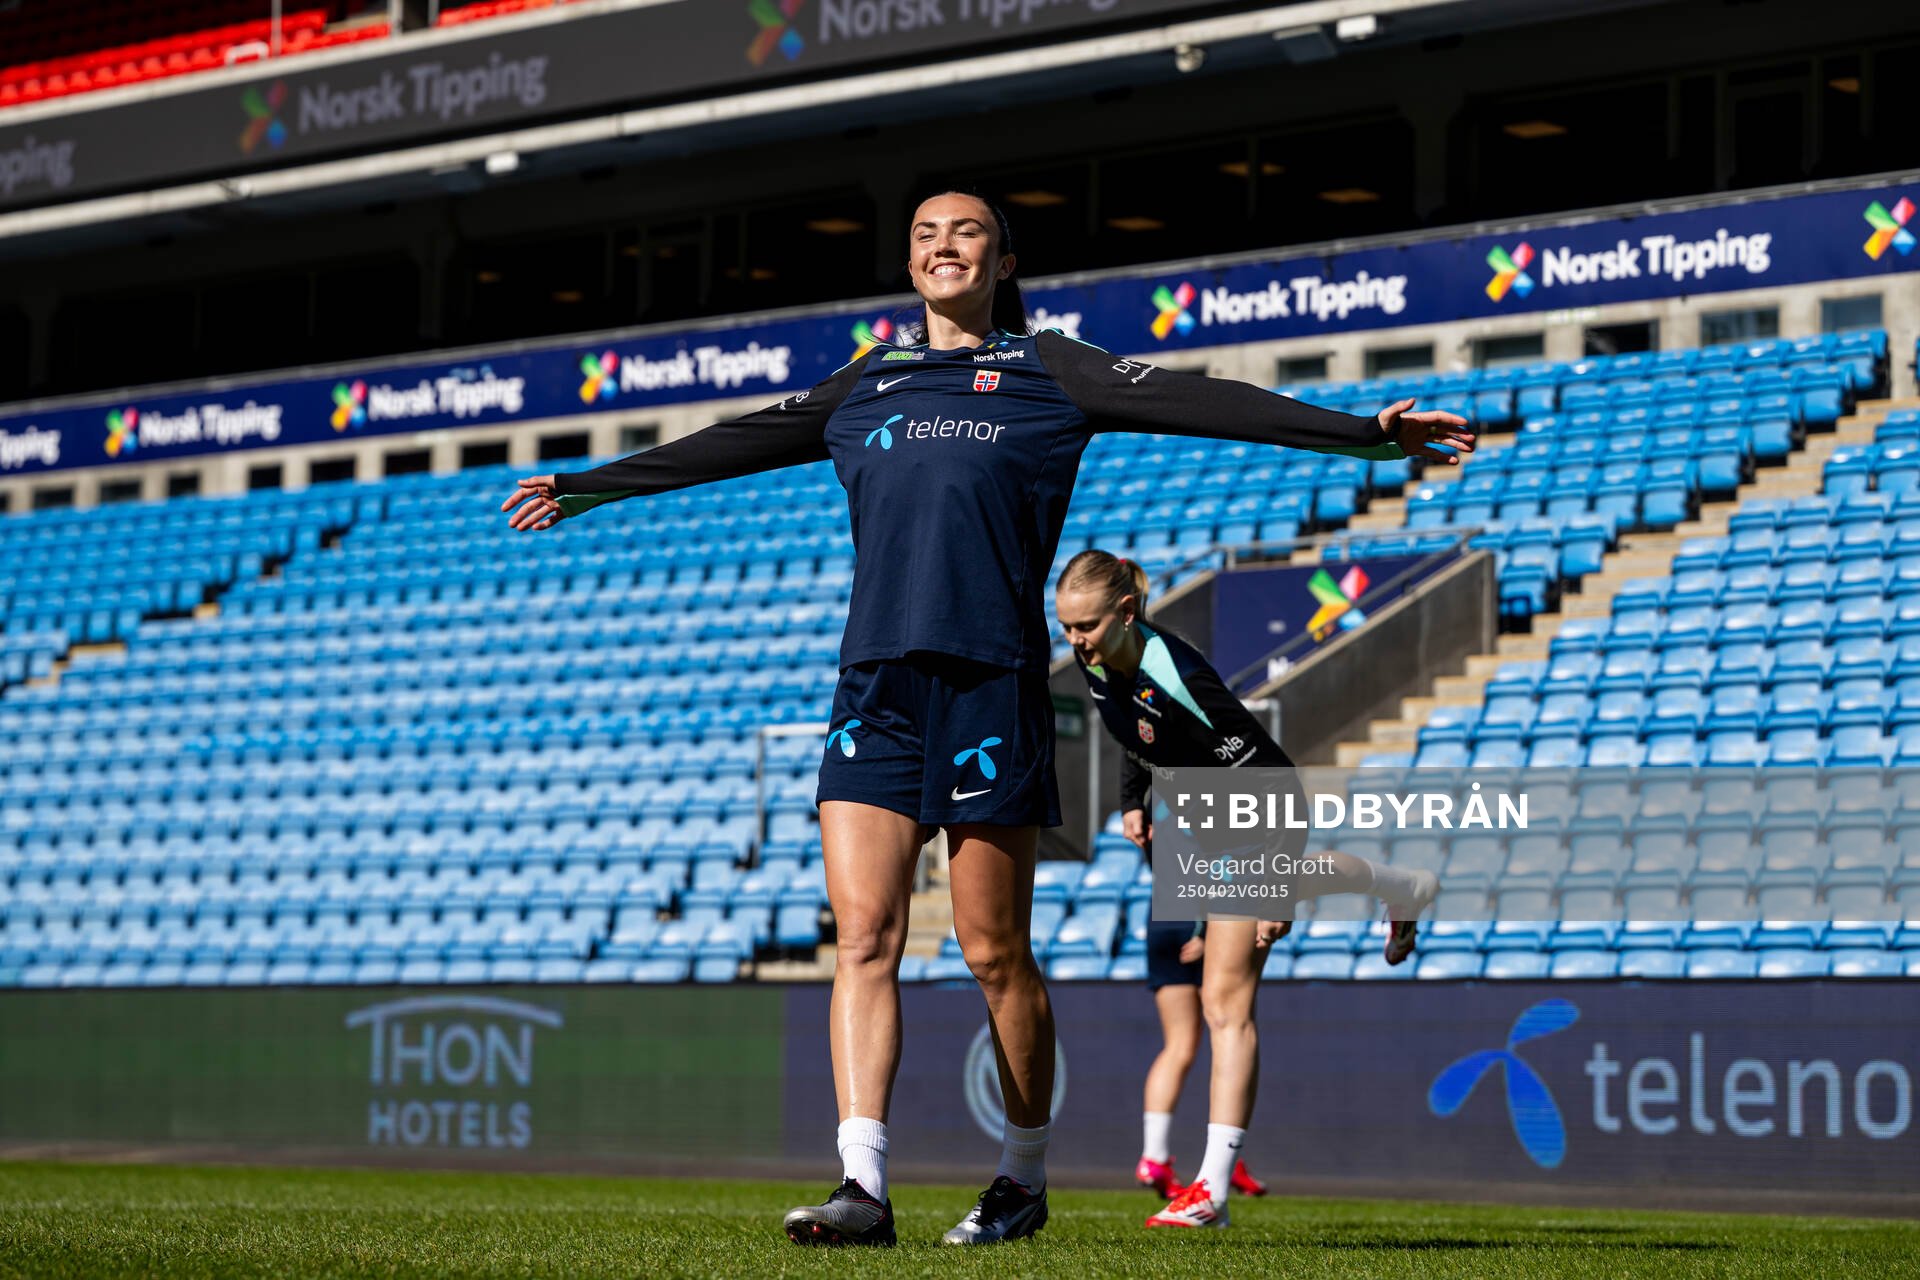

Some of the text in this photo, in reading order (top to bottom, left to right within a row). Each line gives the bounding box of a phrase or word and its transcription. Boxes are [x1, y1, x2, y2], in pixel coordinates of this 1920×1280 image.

[297, 52, 549, 134] Norsk Tipping
[1542, 228, 1772, 287] Norsk Tipping
[1201, 270, 1407, 327] Norsk Tipping
[620, 341, 791, 393] Norsk Tipping
[973, 349, 1025, 363] Norsk Tipping
[906, 415, 1006, 443] telenor
[1214, 736, 1245, 760] DNB
[346, 995, 563, 1086] THON
[1584, 1031, 1913, 1139] teleno
[368, 1100, 532, 1148] HOTELS
